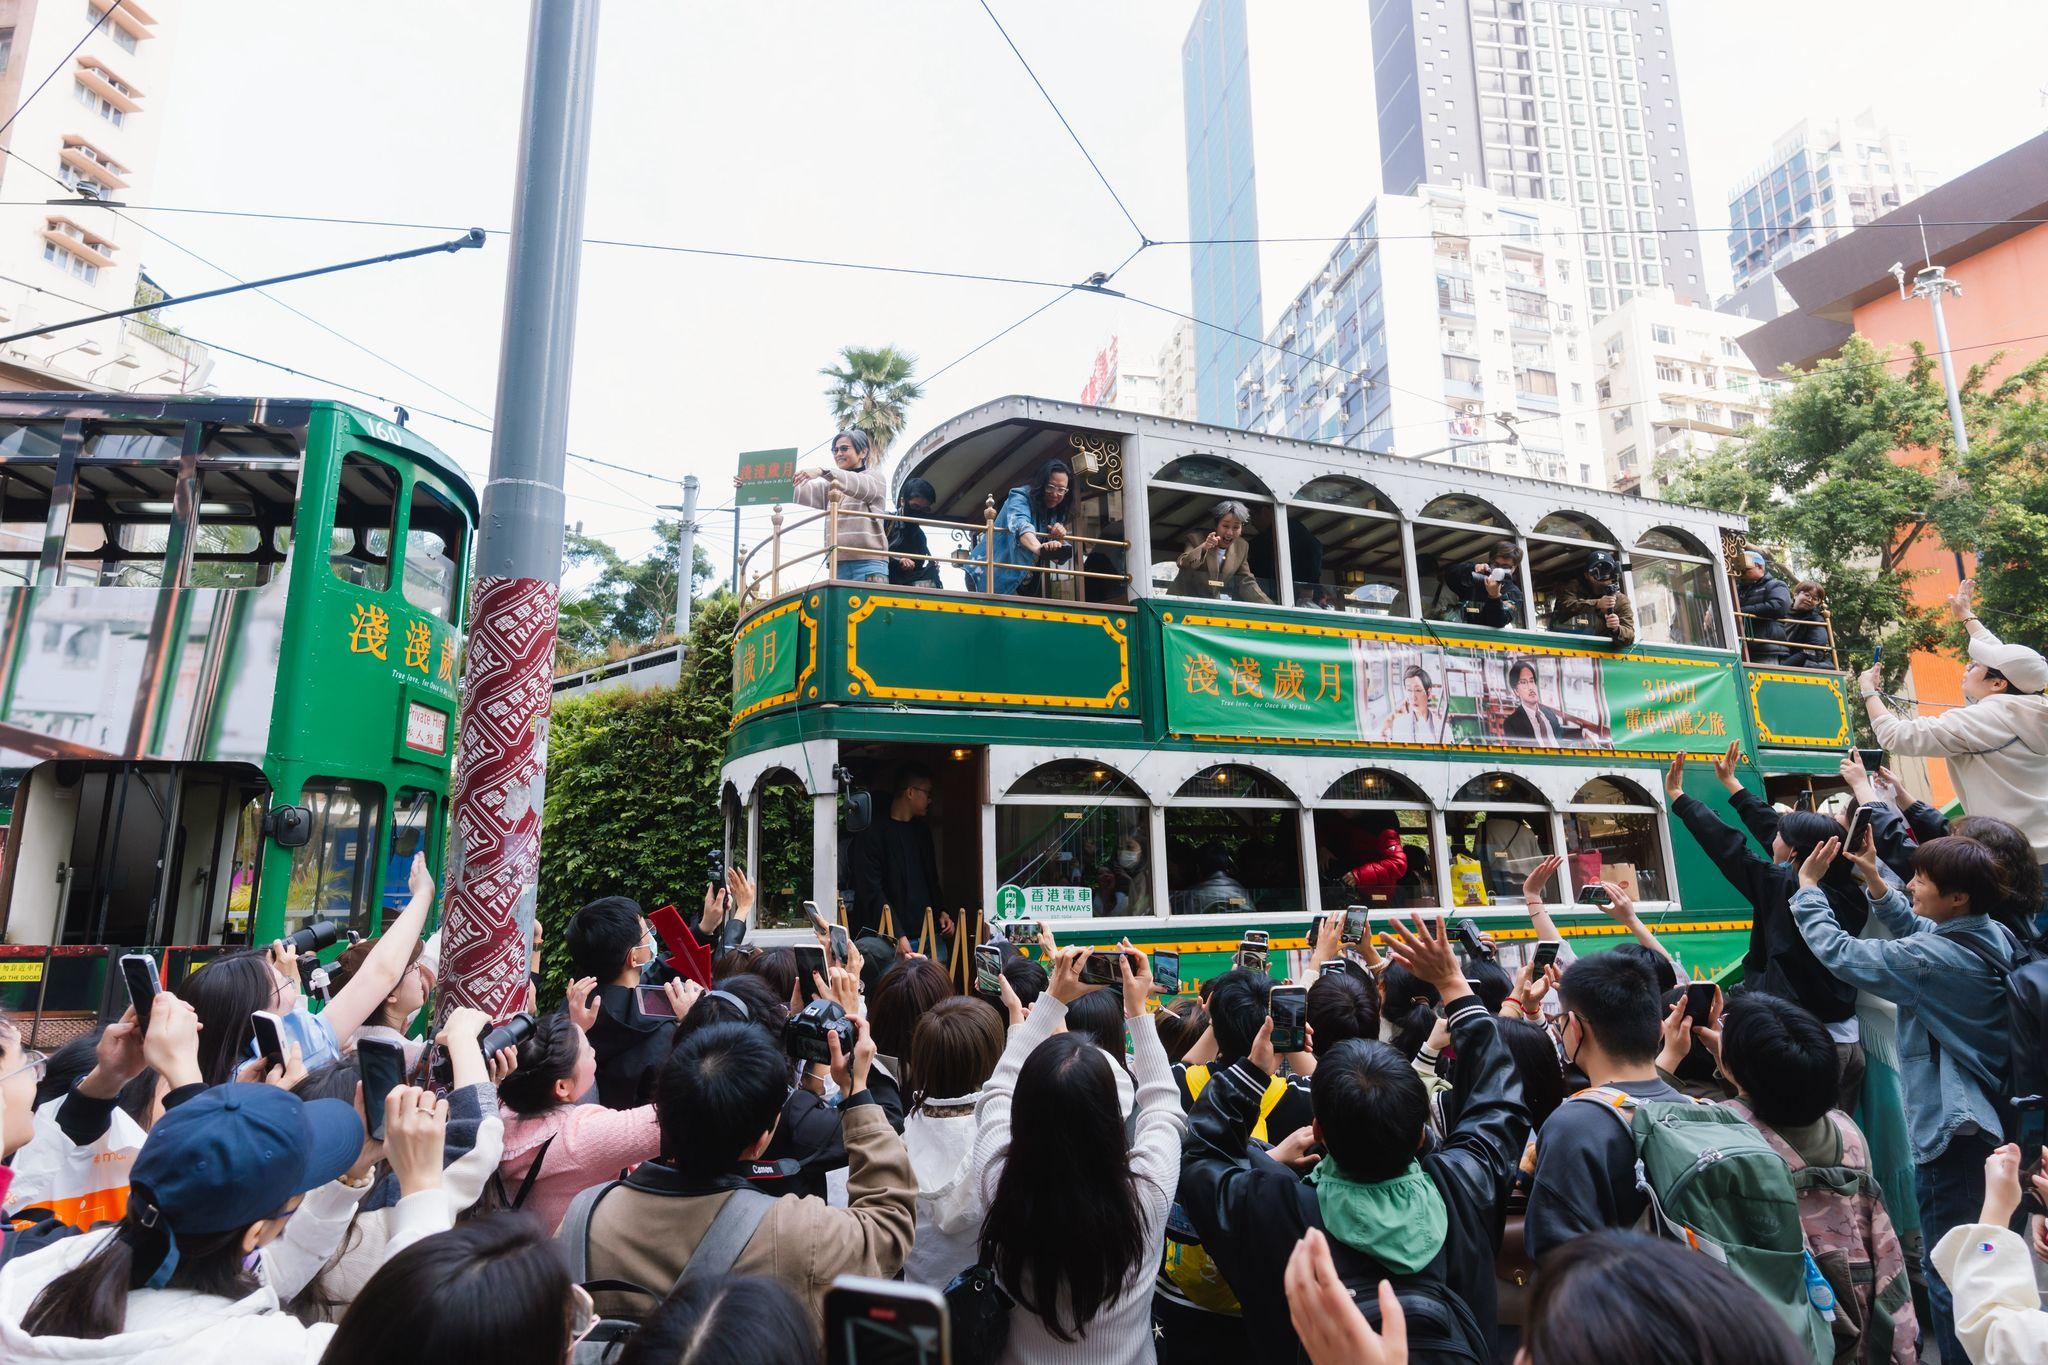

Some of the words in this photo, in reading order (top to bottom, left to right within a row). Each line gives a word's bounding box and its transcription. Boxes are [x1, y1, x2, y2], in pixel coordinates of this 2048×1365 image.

[368, 417, 402, 446] 160
[1184, 653, 1342, 703] 淺淺歲月
[1642, 678, 1696, 704] 3月8日
[1032, 888, 1091, 902] 香港電車
[752, 1165, 774, 1174] Canon
